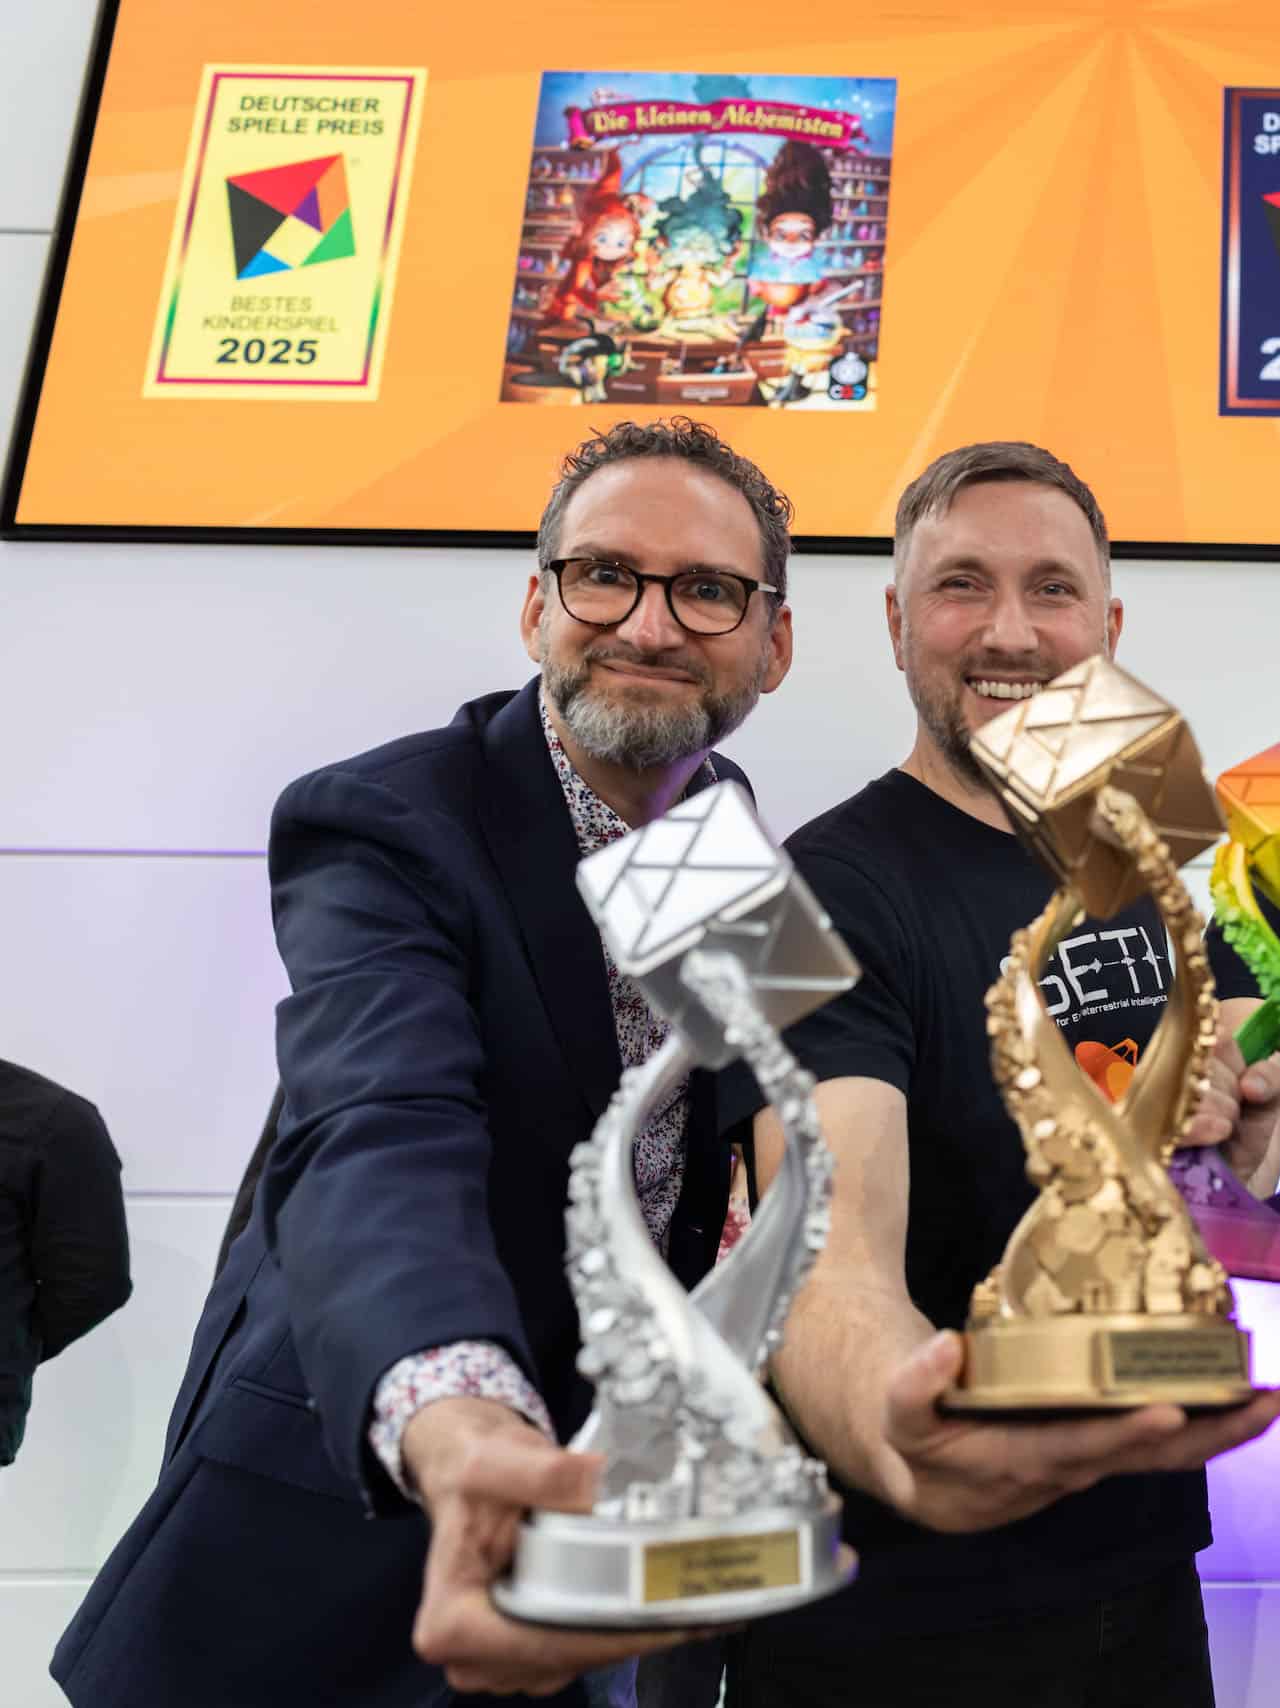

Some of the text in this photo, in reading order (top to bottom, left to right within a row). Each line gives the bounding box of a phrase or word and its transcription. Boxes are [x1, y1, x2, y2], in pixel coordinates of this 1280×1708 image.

[240, 95, 380, 113] DEUTSCHER
[227, 117, 384, 135] SPIELE PREIS
[593, 105, 843, 138] Die kleinen Alchemisten
[230, 295, 312, 313] BESTES
[202, 315, 340, 333] KINDERSPIEL
[216, 338, 320, 364] 2025
